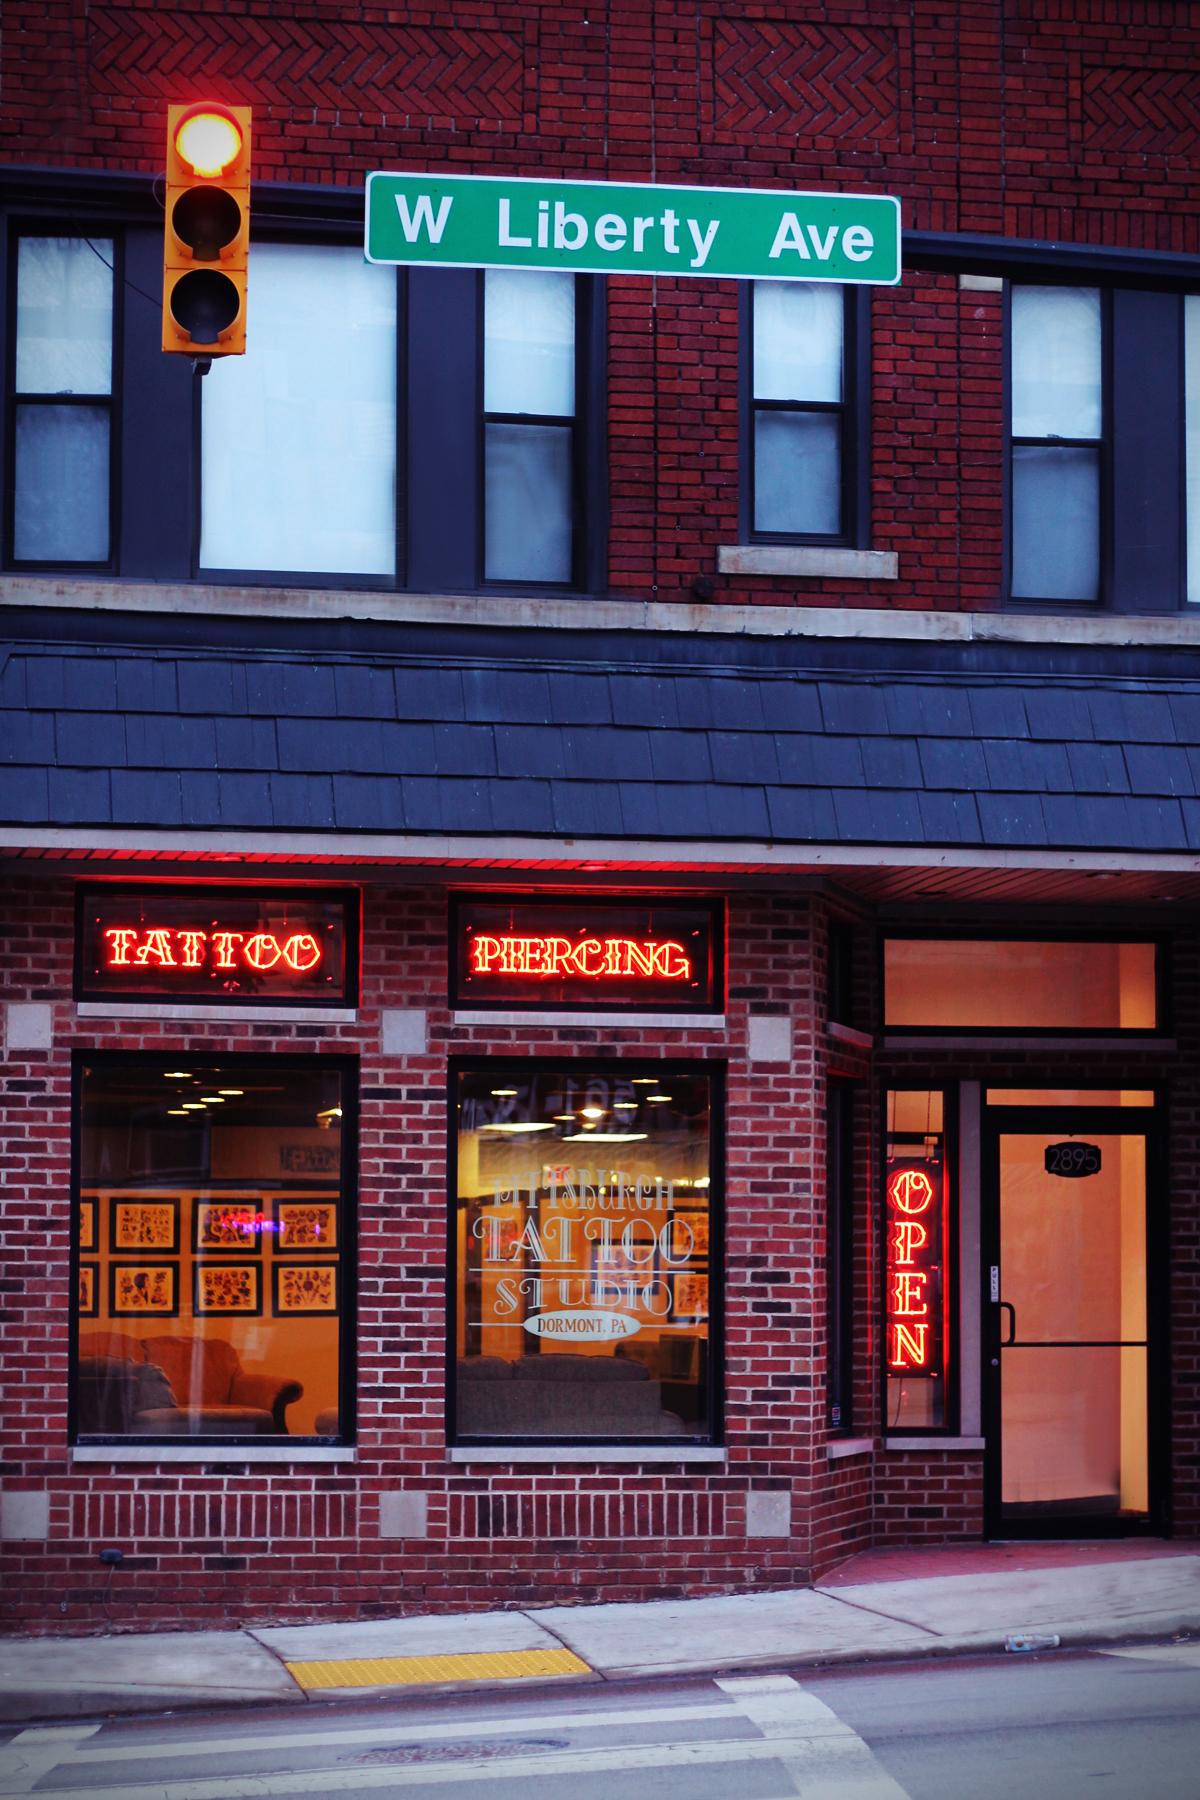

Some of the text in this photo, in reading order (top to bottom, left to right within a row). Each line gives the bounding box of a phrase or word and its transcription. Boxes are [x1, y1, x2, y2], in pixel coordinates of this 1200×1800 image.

[395, 194, 875, 268] W Liberty Ave
[105, 928, 322, 972] TATTOO
[473, 935, 691, 980] PIERCING
[1050, 1148, 1098, 1172] 2895
[493, 1168, 676, 1211] PITTSBURGH
[472, 1215, 695, 1265] TATTOO
[889, 1170, 934, 1366] OPEN
[493, 1278, 673, 1316] STUDIO
[611, 1319, 628, 1333] PA
